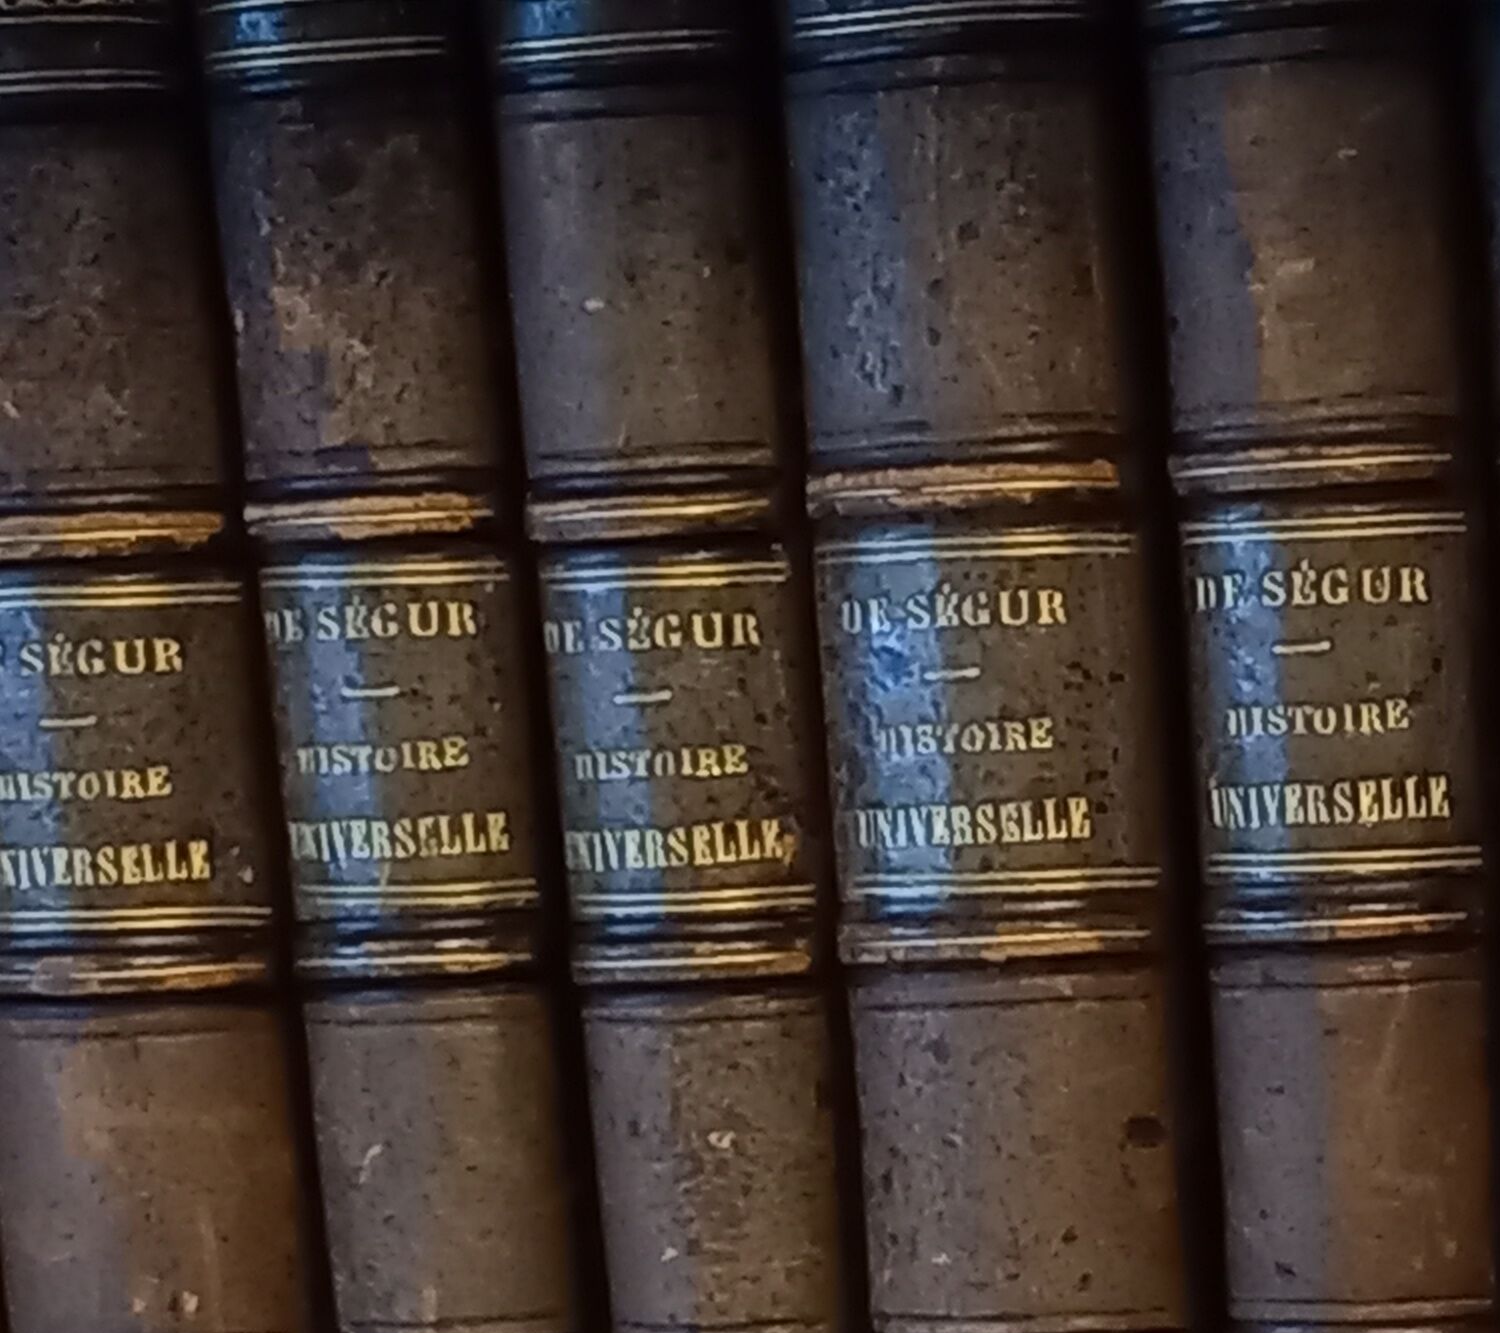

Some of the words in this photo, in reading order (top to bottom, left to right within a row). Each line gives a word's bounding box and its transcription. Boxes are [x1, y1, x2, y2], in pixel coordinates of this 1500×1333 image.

[841, 598, 891, 635] DE
[907, 583, 1067, 629] SÉGUR
[1196, 573, 1244, 611] DE
[1262, 559, 1429, 607] SÉGUR
[264, 608, 304, 643] DE
[316, 595, 478, 641] SÉGUR
[543, 620, 585, 654] DE
[599, 606, 762, 652] SÉGUR
[20, 633, 183, 677] SÉGUR
[879, 717, 1053, 757] HISTOIRE
[1227, 699, 1409, 736] HISTOIRE
[297, 736, 471, 776] HISTOIRE
[575, 745, 749, 780] HISTOIRE
[856, 797, 1092, 849] UNIVERSELLE
[1211, 775, 1450, 829] UNIVERSELLE
